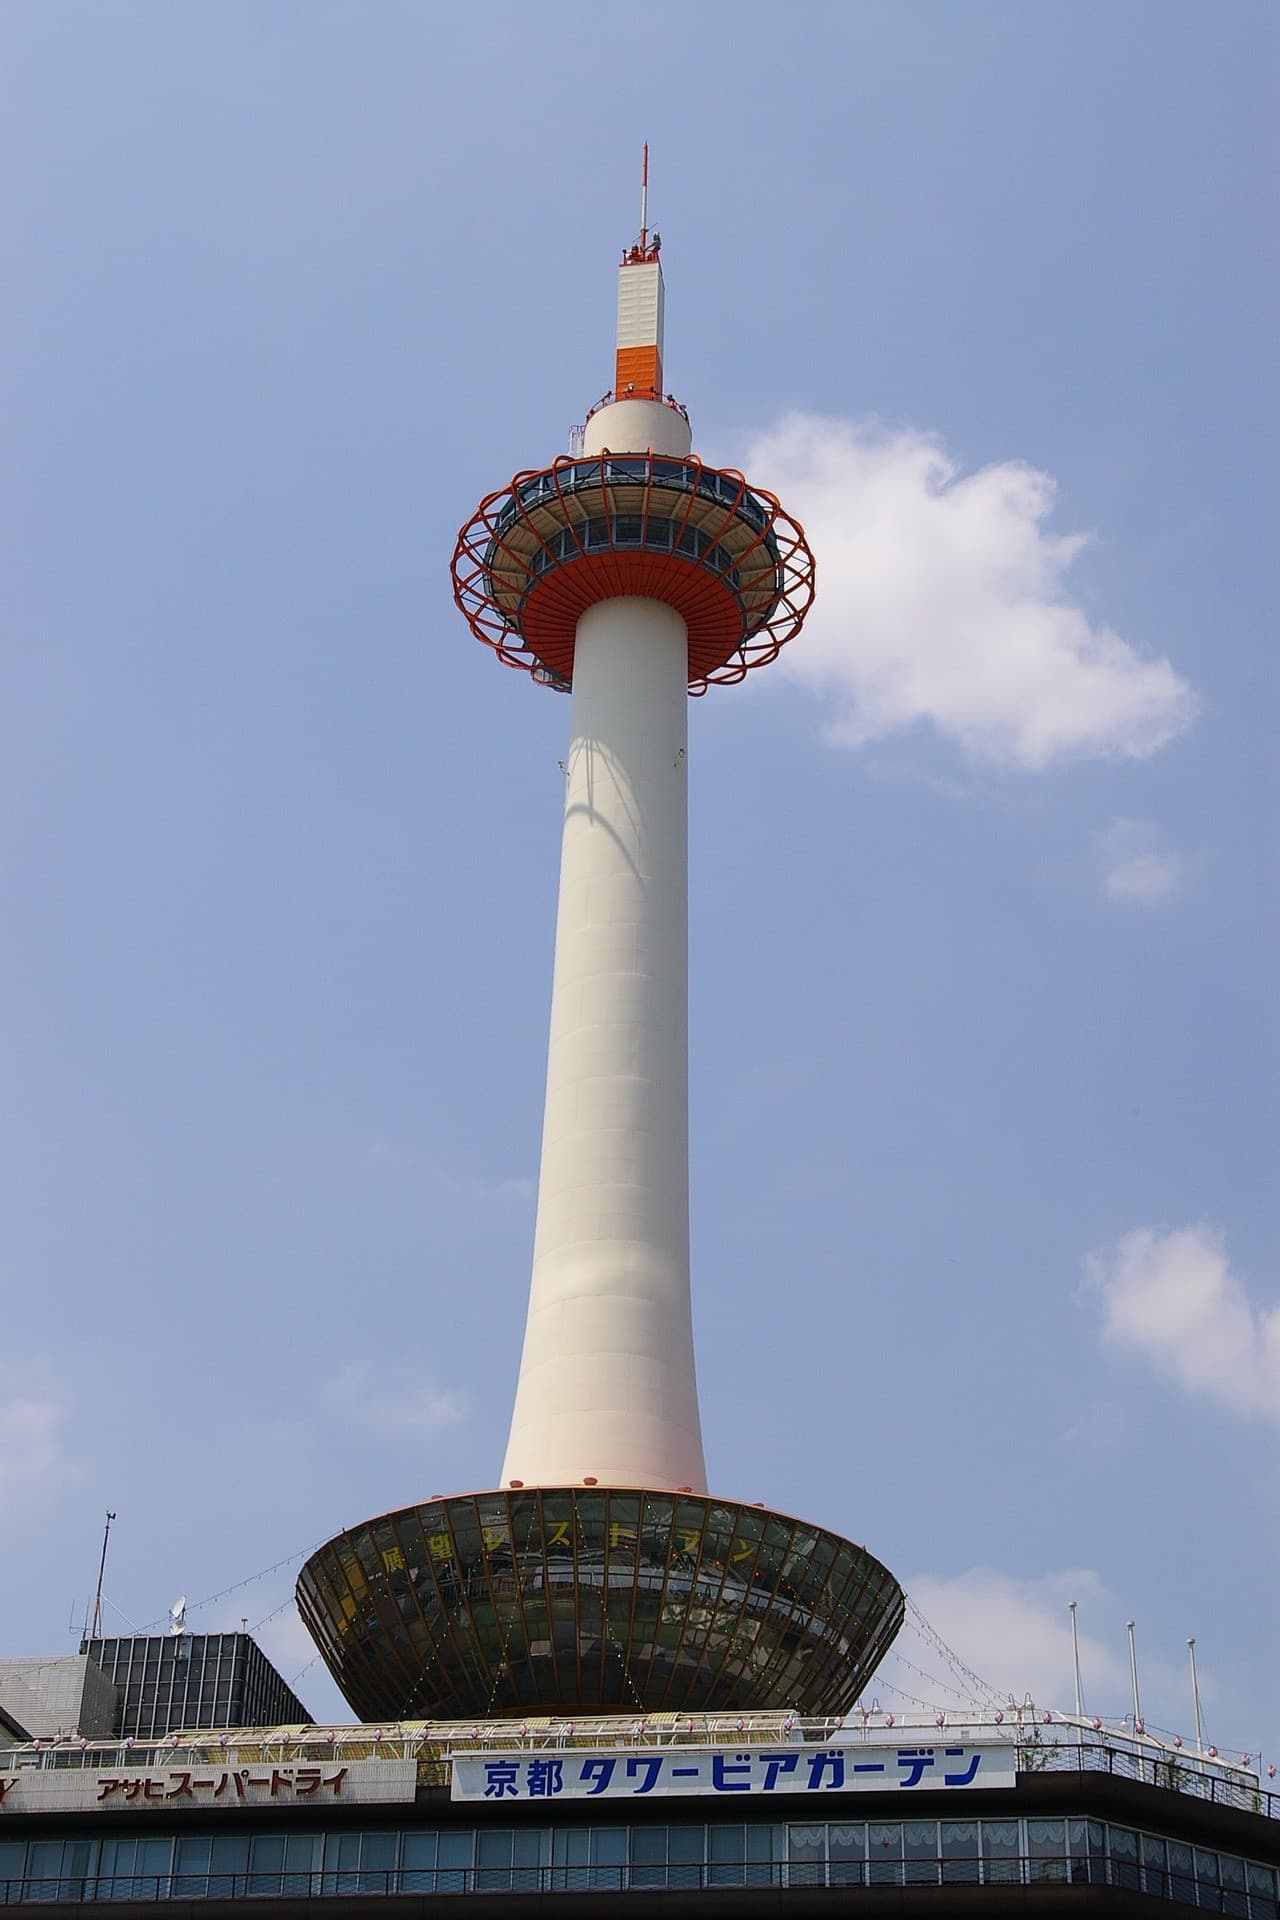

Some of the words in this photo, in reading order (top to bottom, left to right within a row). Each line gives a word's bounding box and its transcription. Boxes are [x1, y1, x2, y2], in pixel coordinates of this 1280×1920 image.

[382, 1521, 756, 1574] 展望レストラン
